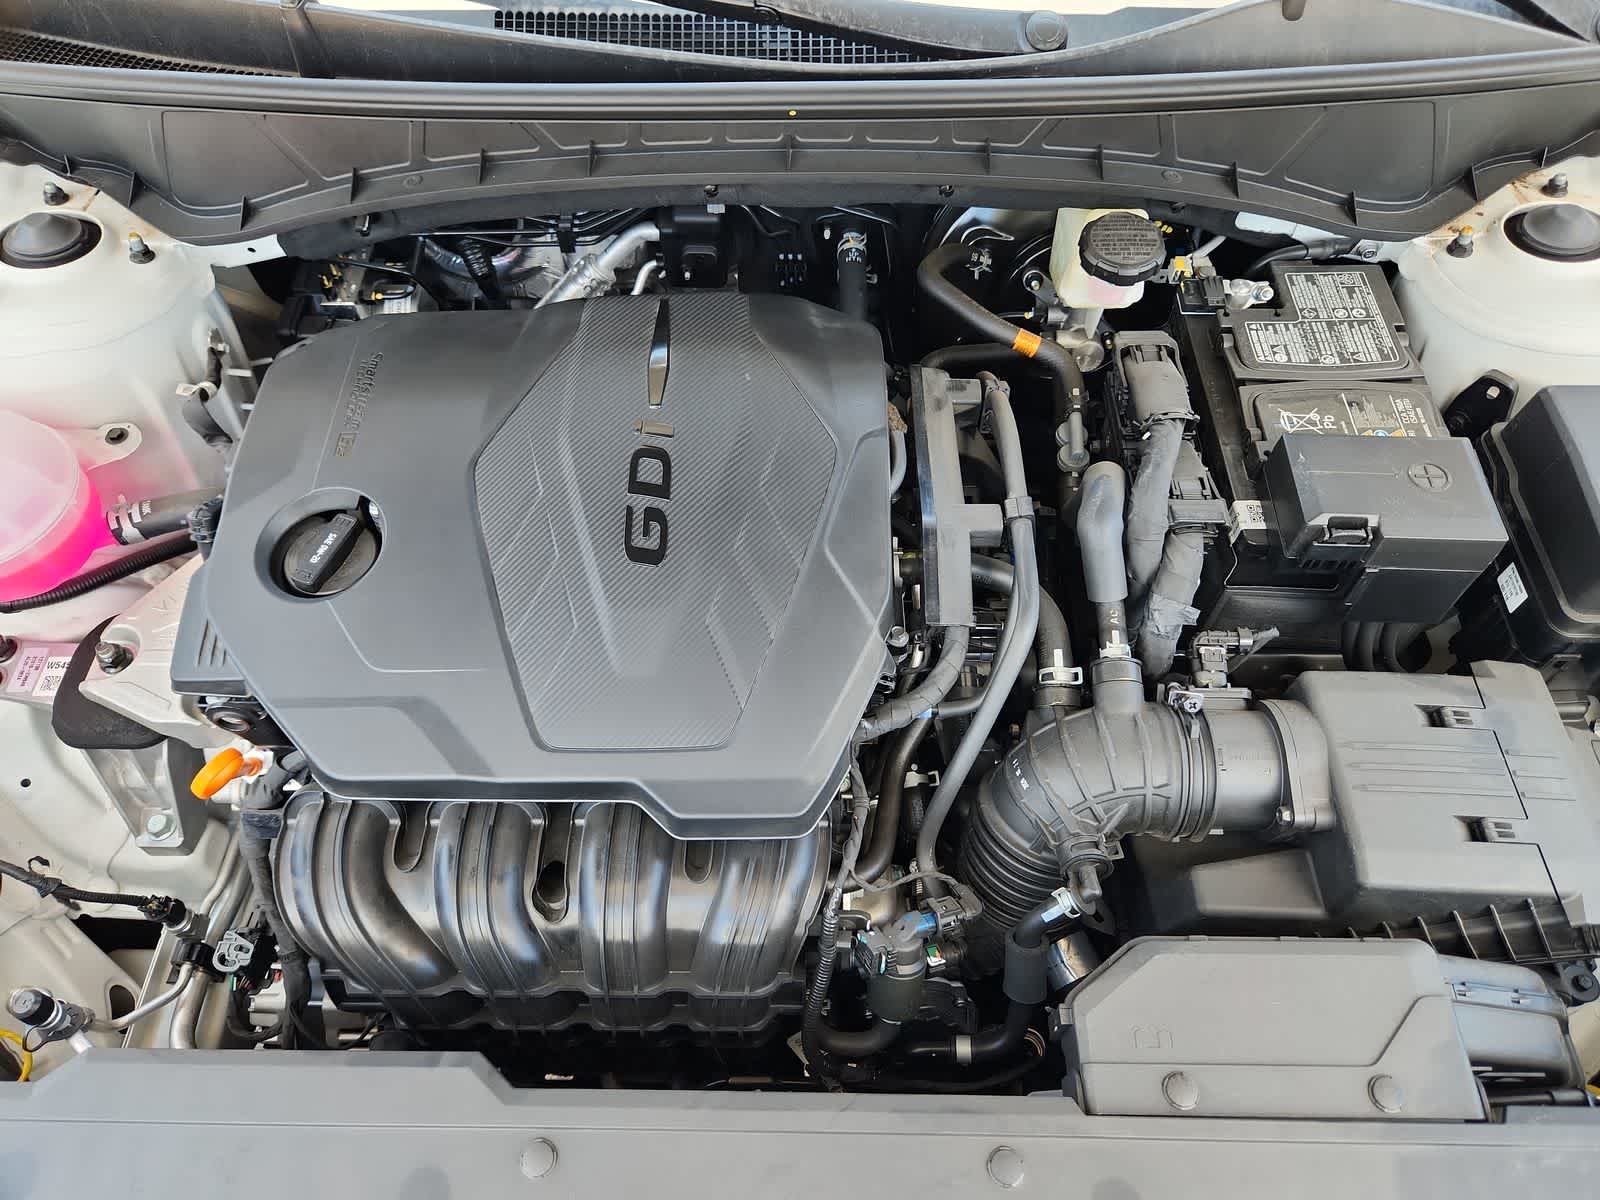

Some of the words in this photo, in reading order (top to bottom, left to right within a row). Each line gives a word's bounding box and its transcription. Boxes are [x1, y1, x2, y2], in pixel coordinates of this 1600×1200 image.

[1323, 415, 1337, 428] Pb
[624, 417, 674, 566] GDi
[323, 532, 338, 546] SAE
